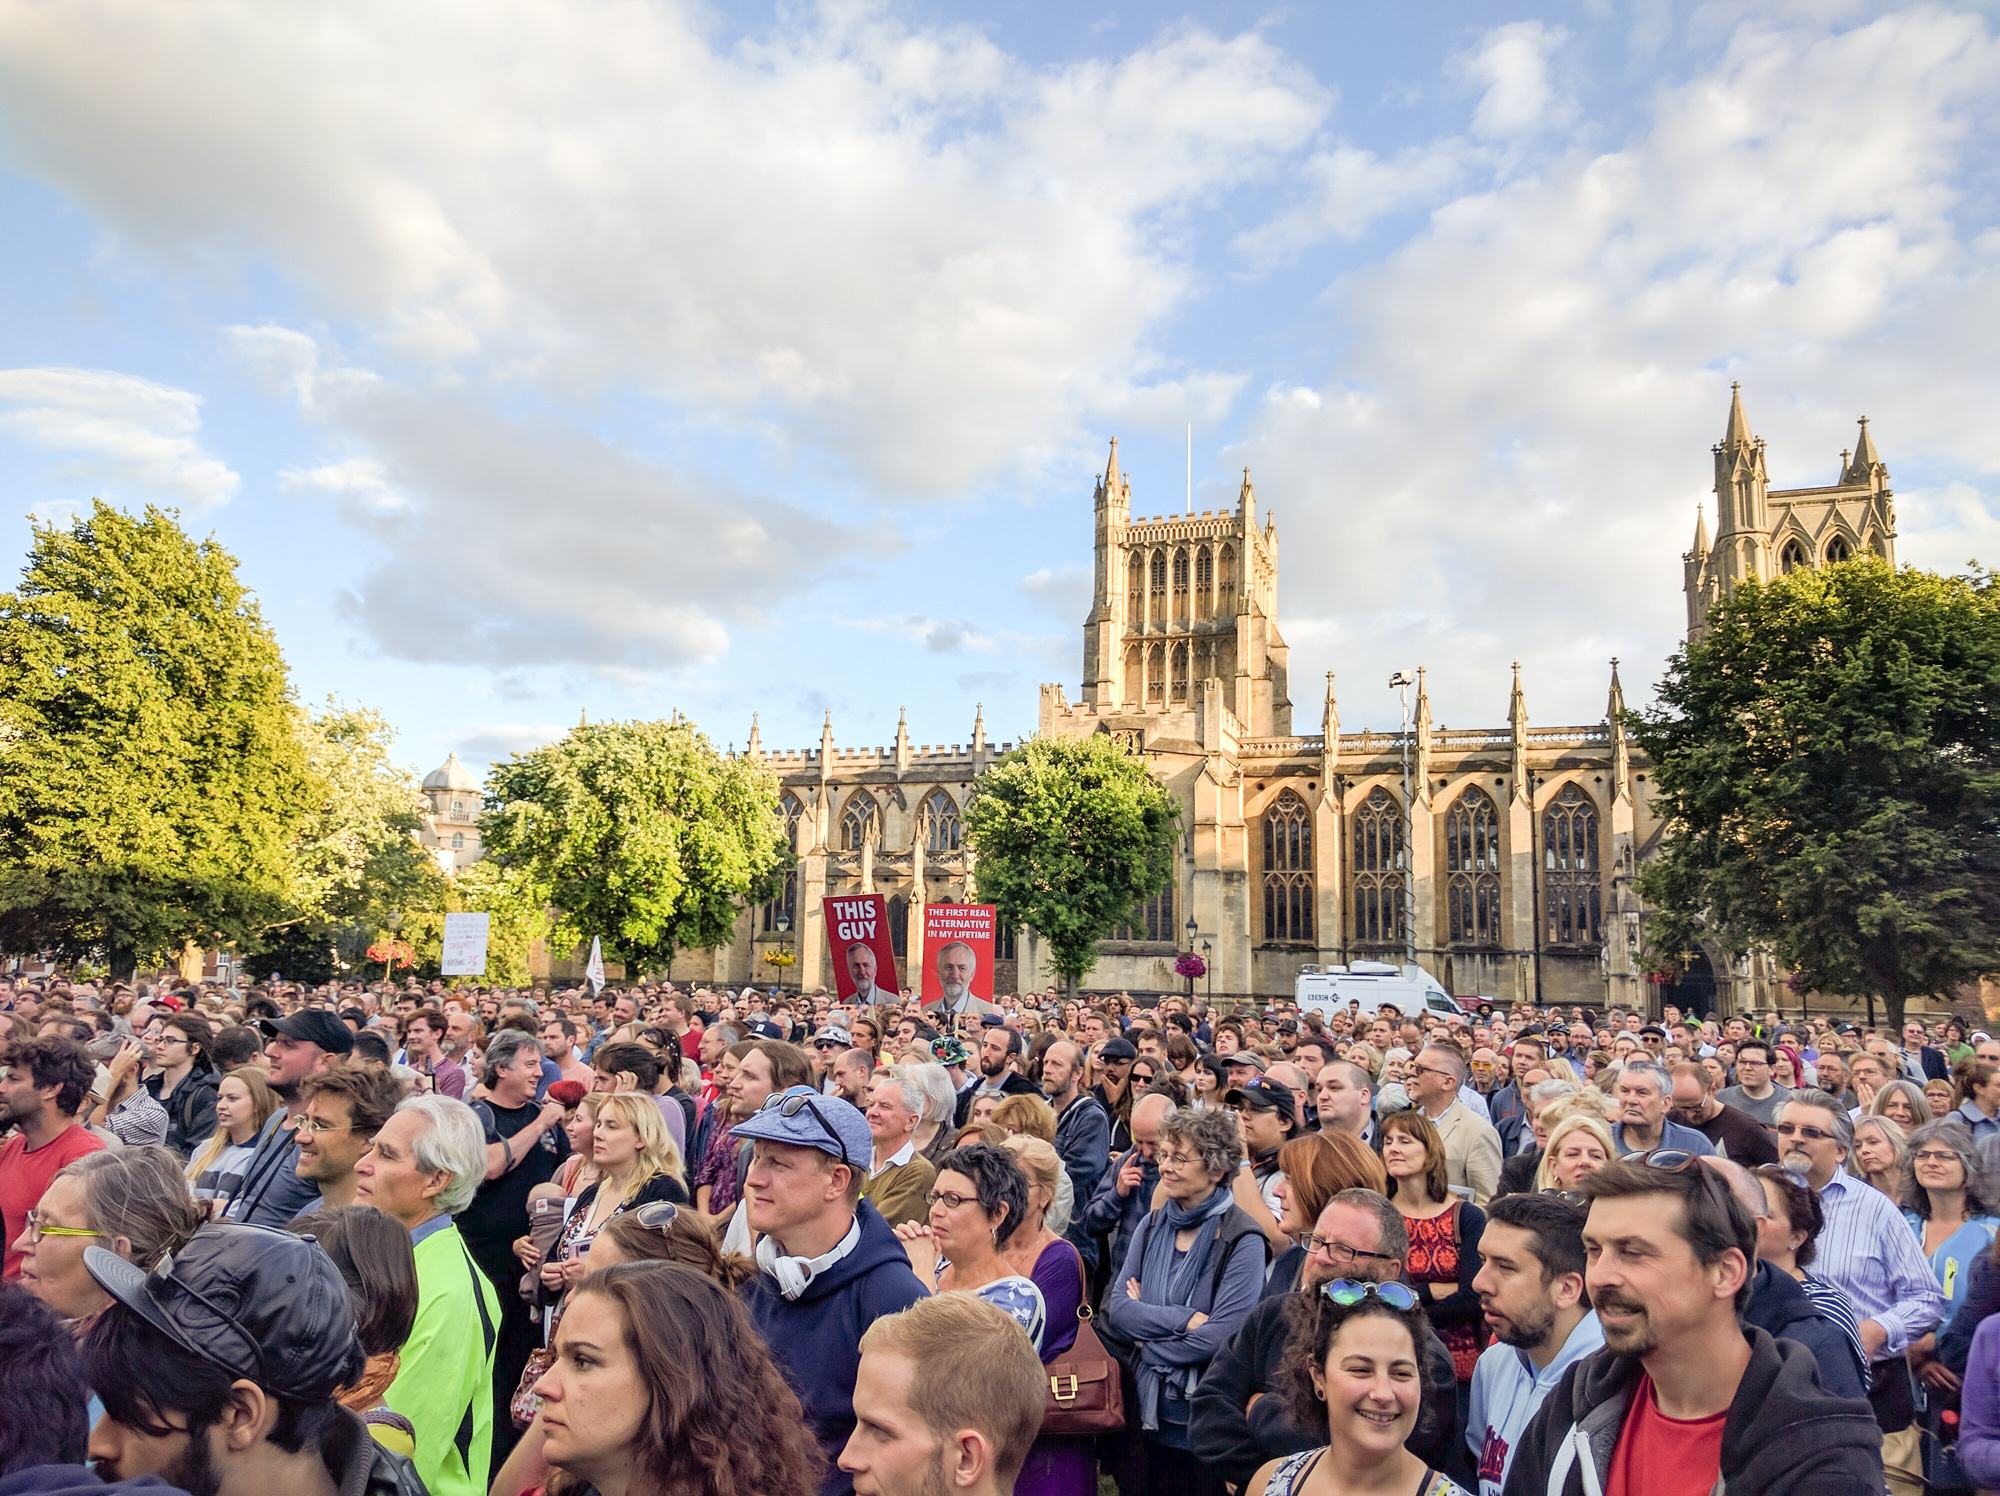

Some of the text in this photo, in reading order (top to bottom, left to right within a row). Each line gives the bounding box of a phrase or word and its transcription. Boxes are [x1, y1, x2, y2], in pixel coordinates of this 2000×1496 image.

[833, 900, 876, 920] THIS
[946, 909, 968, 917] FIRST
[970, 910, 991, 918] REAL
[928, 920, 990, 928] ALTERNATIVE
[838, 920, 876, 940] GUY
[954, 931, 990, 939] LIFETIME
